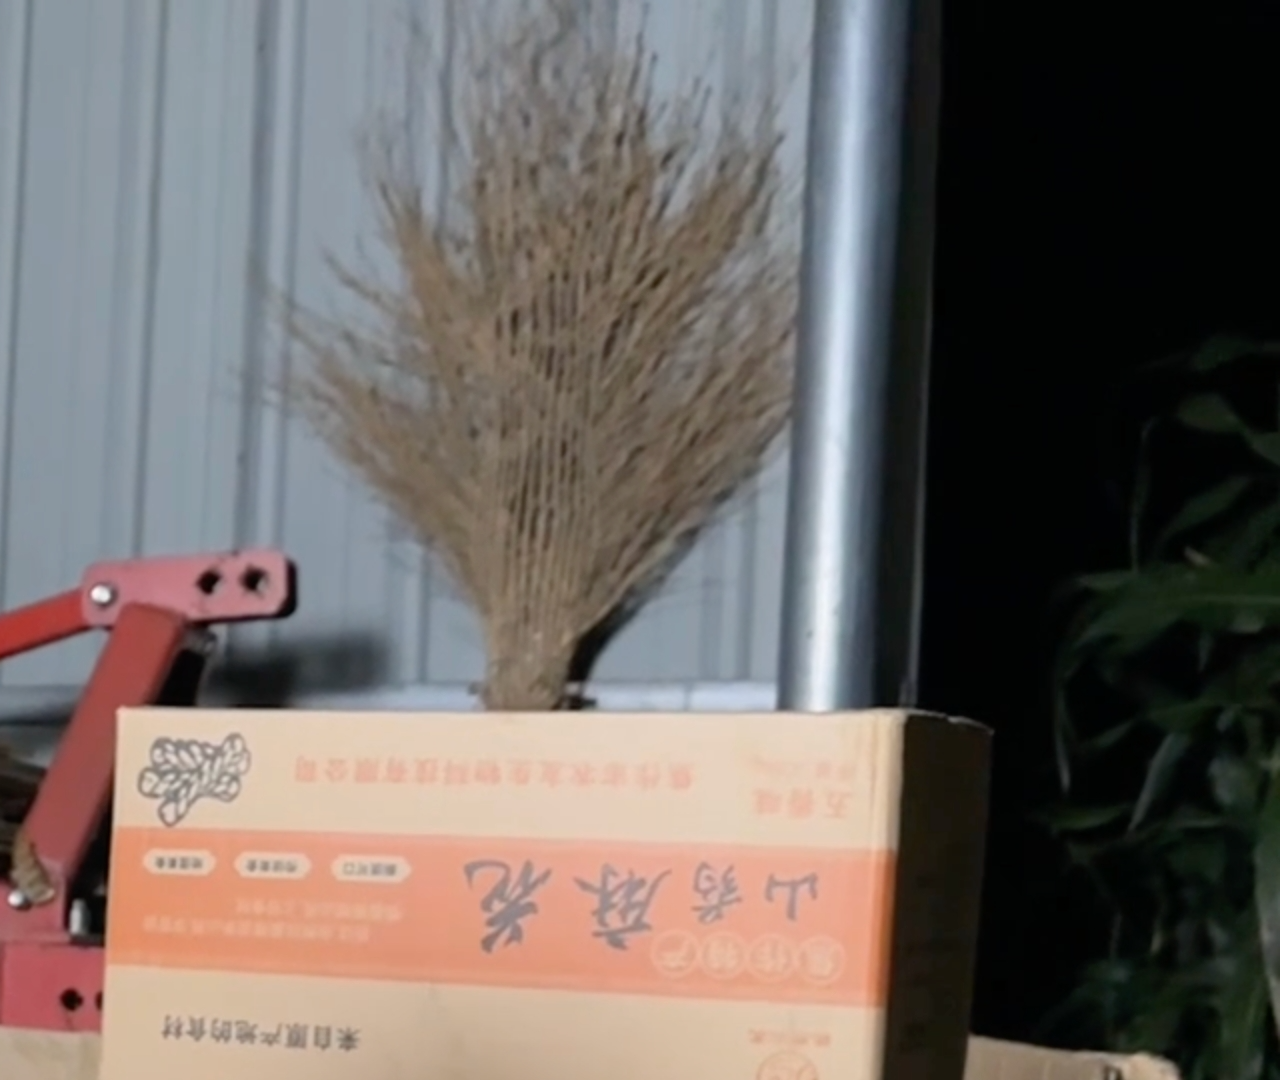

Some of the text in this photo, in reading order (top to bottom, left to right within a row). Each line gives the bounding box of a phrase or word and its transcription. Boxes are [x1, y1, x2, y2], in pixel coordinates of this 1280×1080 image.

[463, 856, 819, 954] 山药麻花
[162, 1014, 360, 1052] 来自原产地的食材
